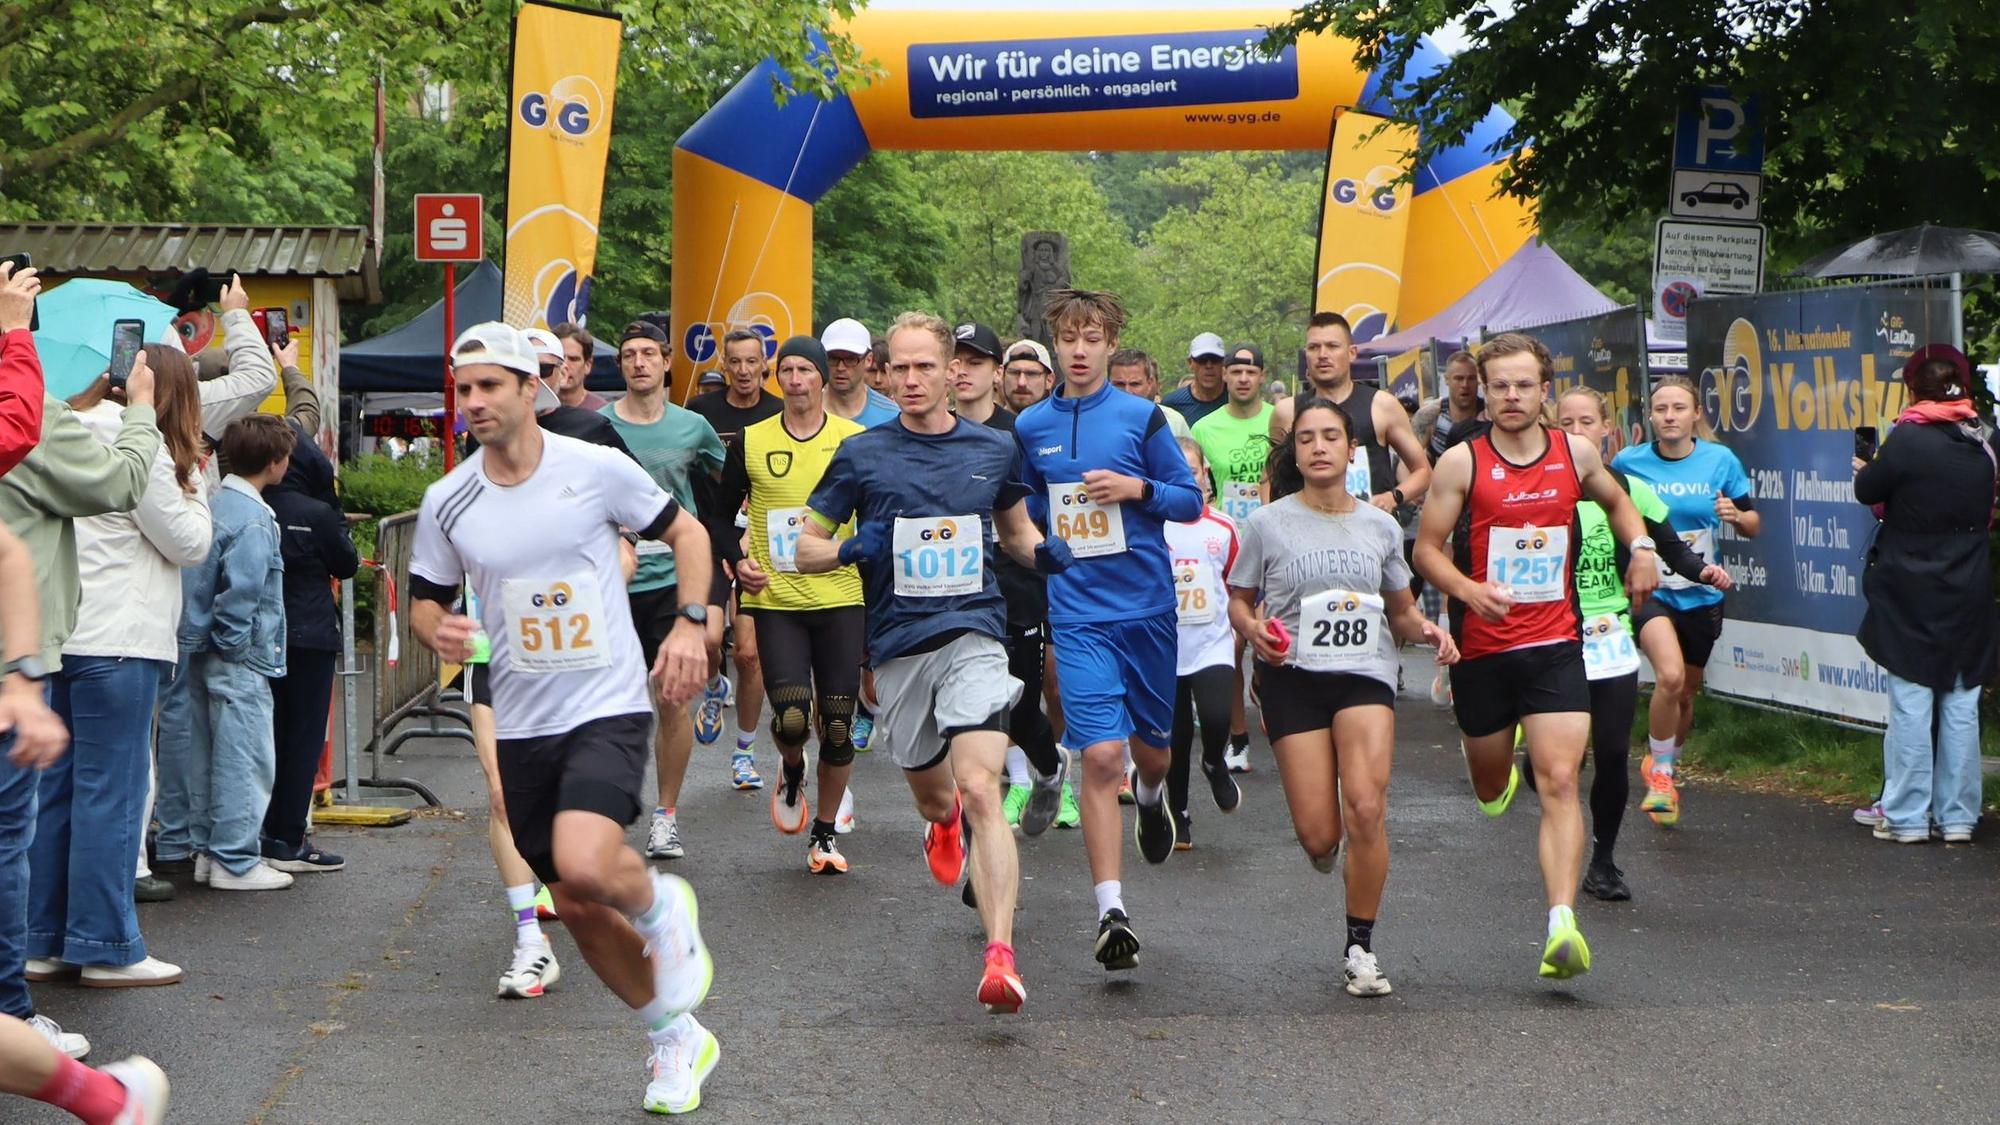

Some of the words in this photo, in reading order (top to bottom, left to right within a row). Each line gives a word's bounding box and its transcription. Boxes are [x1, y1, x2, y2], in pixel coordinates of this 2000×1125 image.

[928, 53, 987, 82] Wir
[996, 51, 1041, 79] für
[1051, 47, 1141, 76] deine
[937, 88, 998, 105] regional
[1012, 83, 1090, 101] persönlich
[1103, 79, 1177, 97] engagiert
[1185, 111, 1280, 123] www.gvg.de
[1695, 98, 1744, 164] P
[1665, 232, 1680, 240] Auf
[1682, 232, 1714, 242] diesem
[1717, 234, 1757, 245] Parkplatz
[1784, 323, 1853, 352] Internationaler
[1062, 493, 1088, 506] GVG
[1758, 469, 1785, 500] 2026
[920, 528, 952, 541] GVG
[1056, 510, 1109, 541] 649
[1795, 515, 1807, 547] 10
[1827, 517, 1834, 549] 5
[1515, 539, 1545, 550] GVG
[898, 546, 979, 578] 1012
[1285, 548, 1380, 592] UNIVERSIT
[1493, 555, 1563, 586] 1257
[1831, 564, 1847, 596] 500
[1847, 575, 1857, 597] m
[532, 592, 568, 609] GVG
[1327, 600, 1356, 613] GVG
[520, 613, 593, 652] 512
[1312, 619, 1368, 648] 288
[1817, 661, 1889, 694] www.volksla
